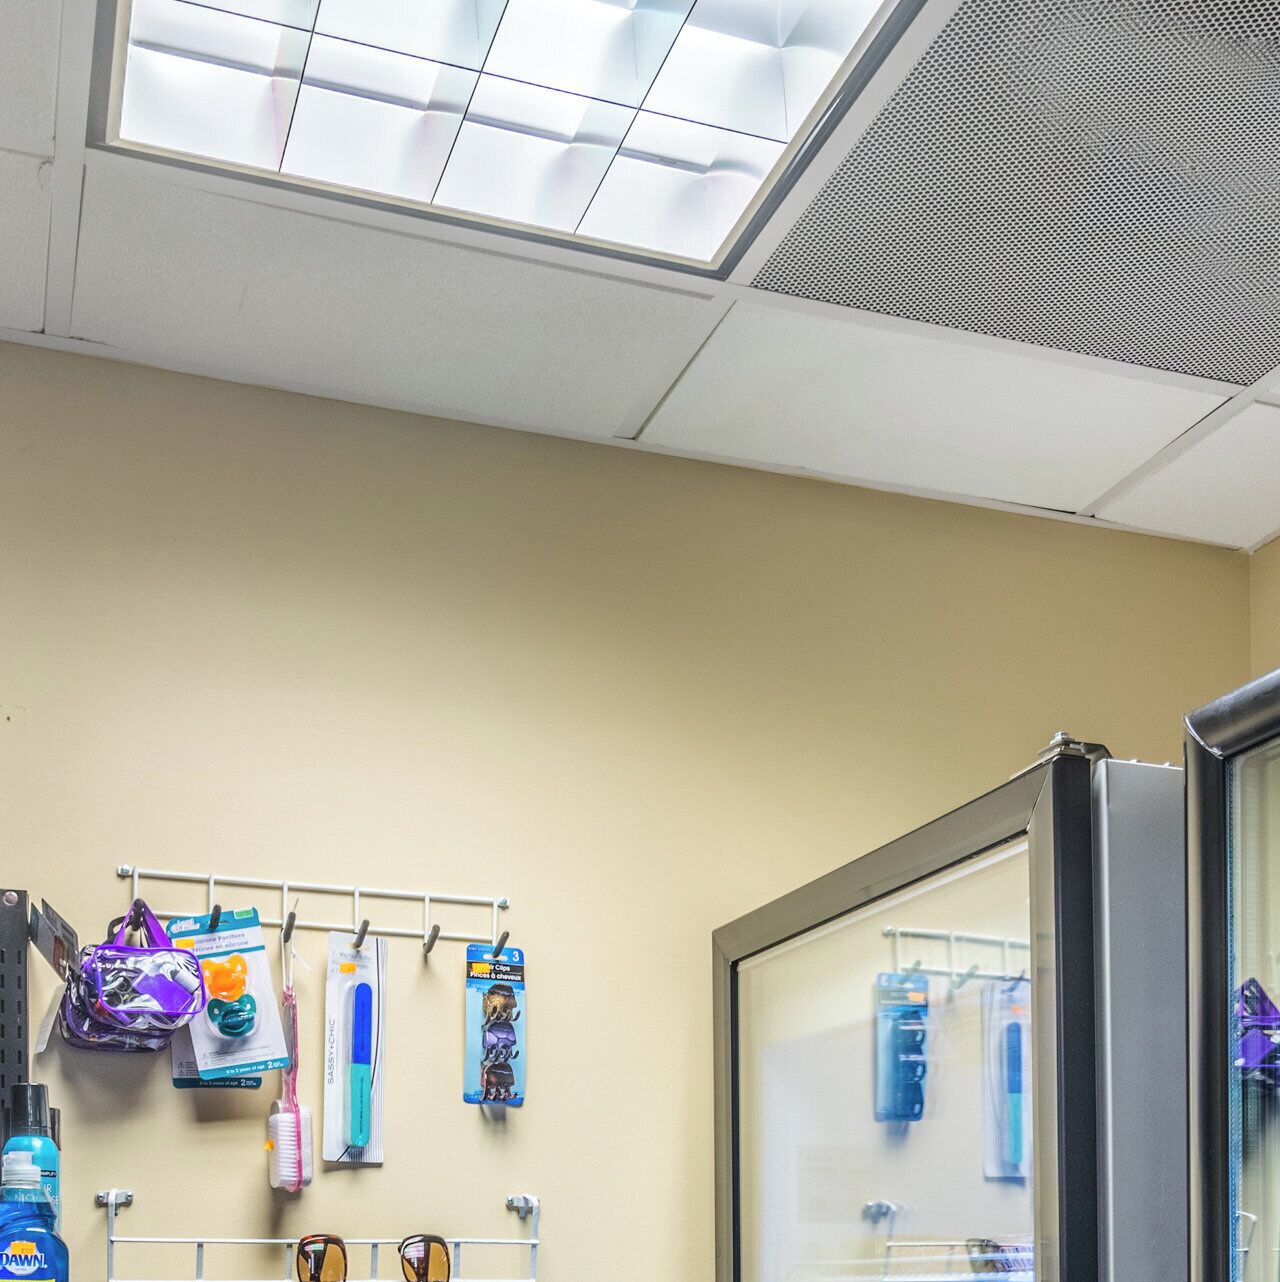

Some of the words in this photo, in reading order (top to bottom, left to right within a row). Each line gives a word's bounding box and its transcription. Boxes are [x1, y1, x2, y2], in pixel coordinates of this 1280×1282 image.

[512, 951, 520, 962] 3
[495, 964, 511, 973] Clips
[497, 972, 522, 981] cheveux
